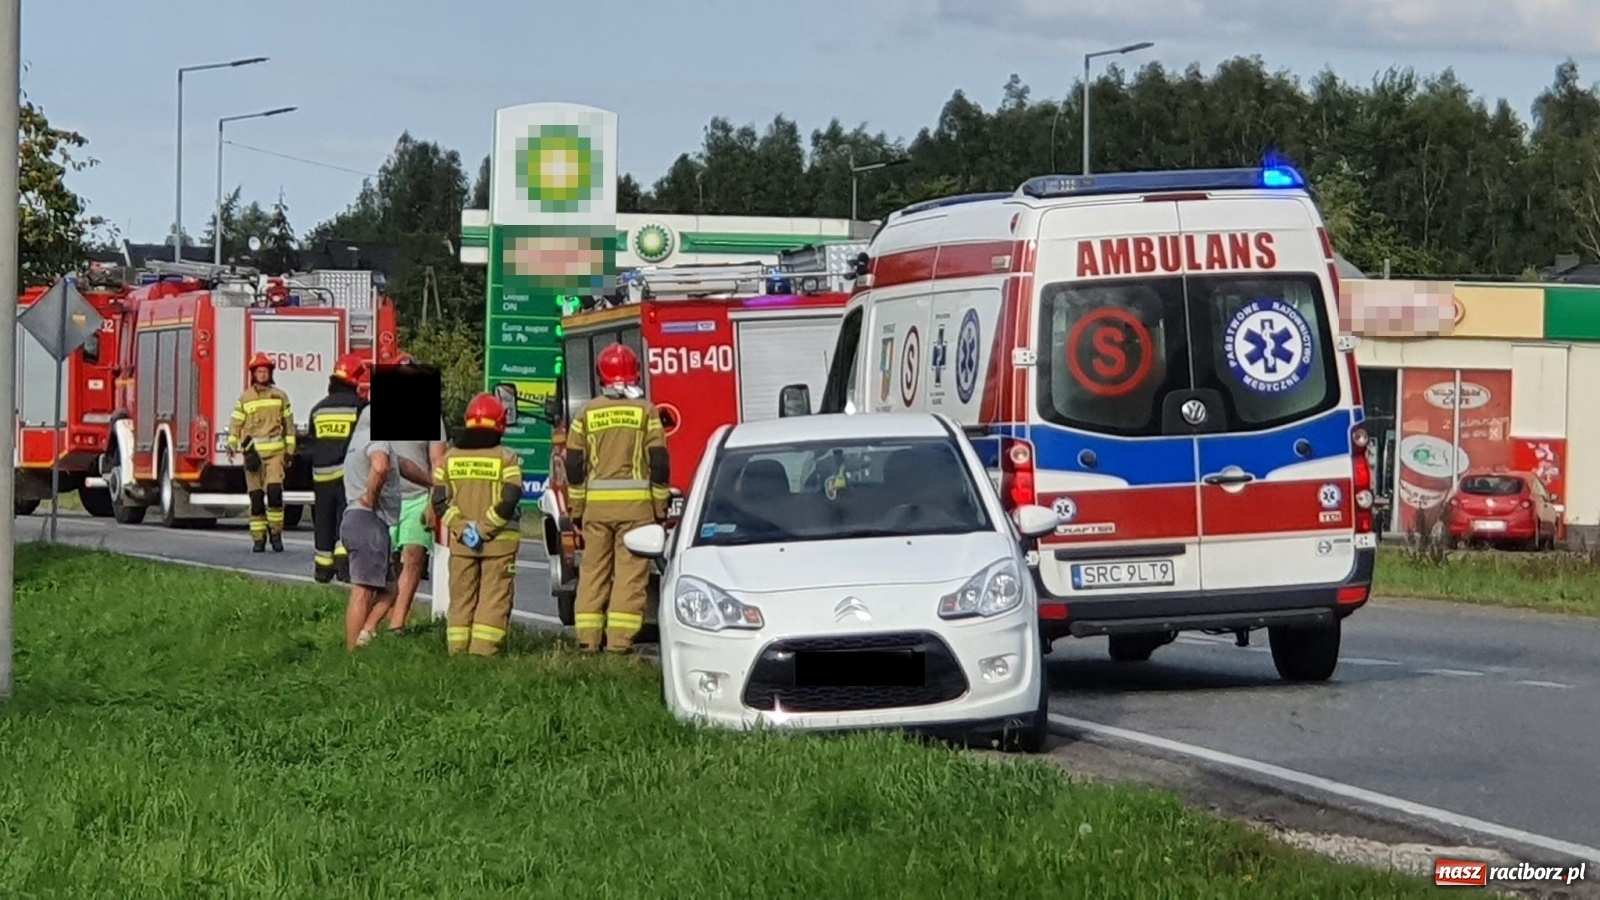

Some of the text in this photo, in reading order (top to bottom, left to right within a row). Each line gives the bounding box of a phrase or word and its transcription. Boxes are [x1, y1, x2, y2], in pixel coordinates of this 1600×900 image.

[1076, 231, 1277, 277] AMBULANS
[1092, 326, 1127, 379] S
[1271, 301, 1312, 364] RATOWNICTWO
[904, 343, 915, 390] S
[1242, 372, 1300, 391] MEDYCZNE
[1084, 563, 1170, 583] SRC 9LT9
